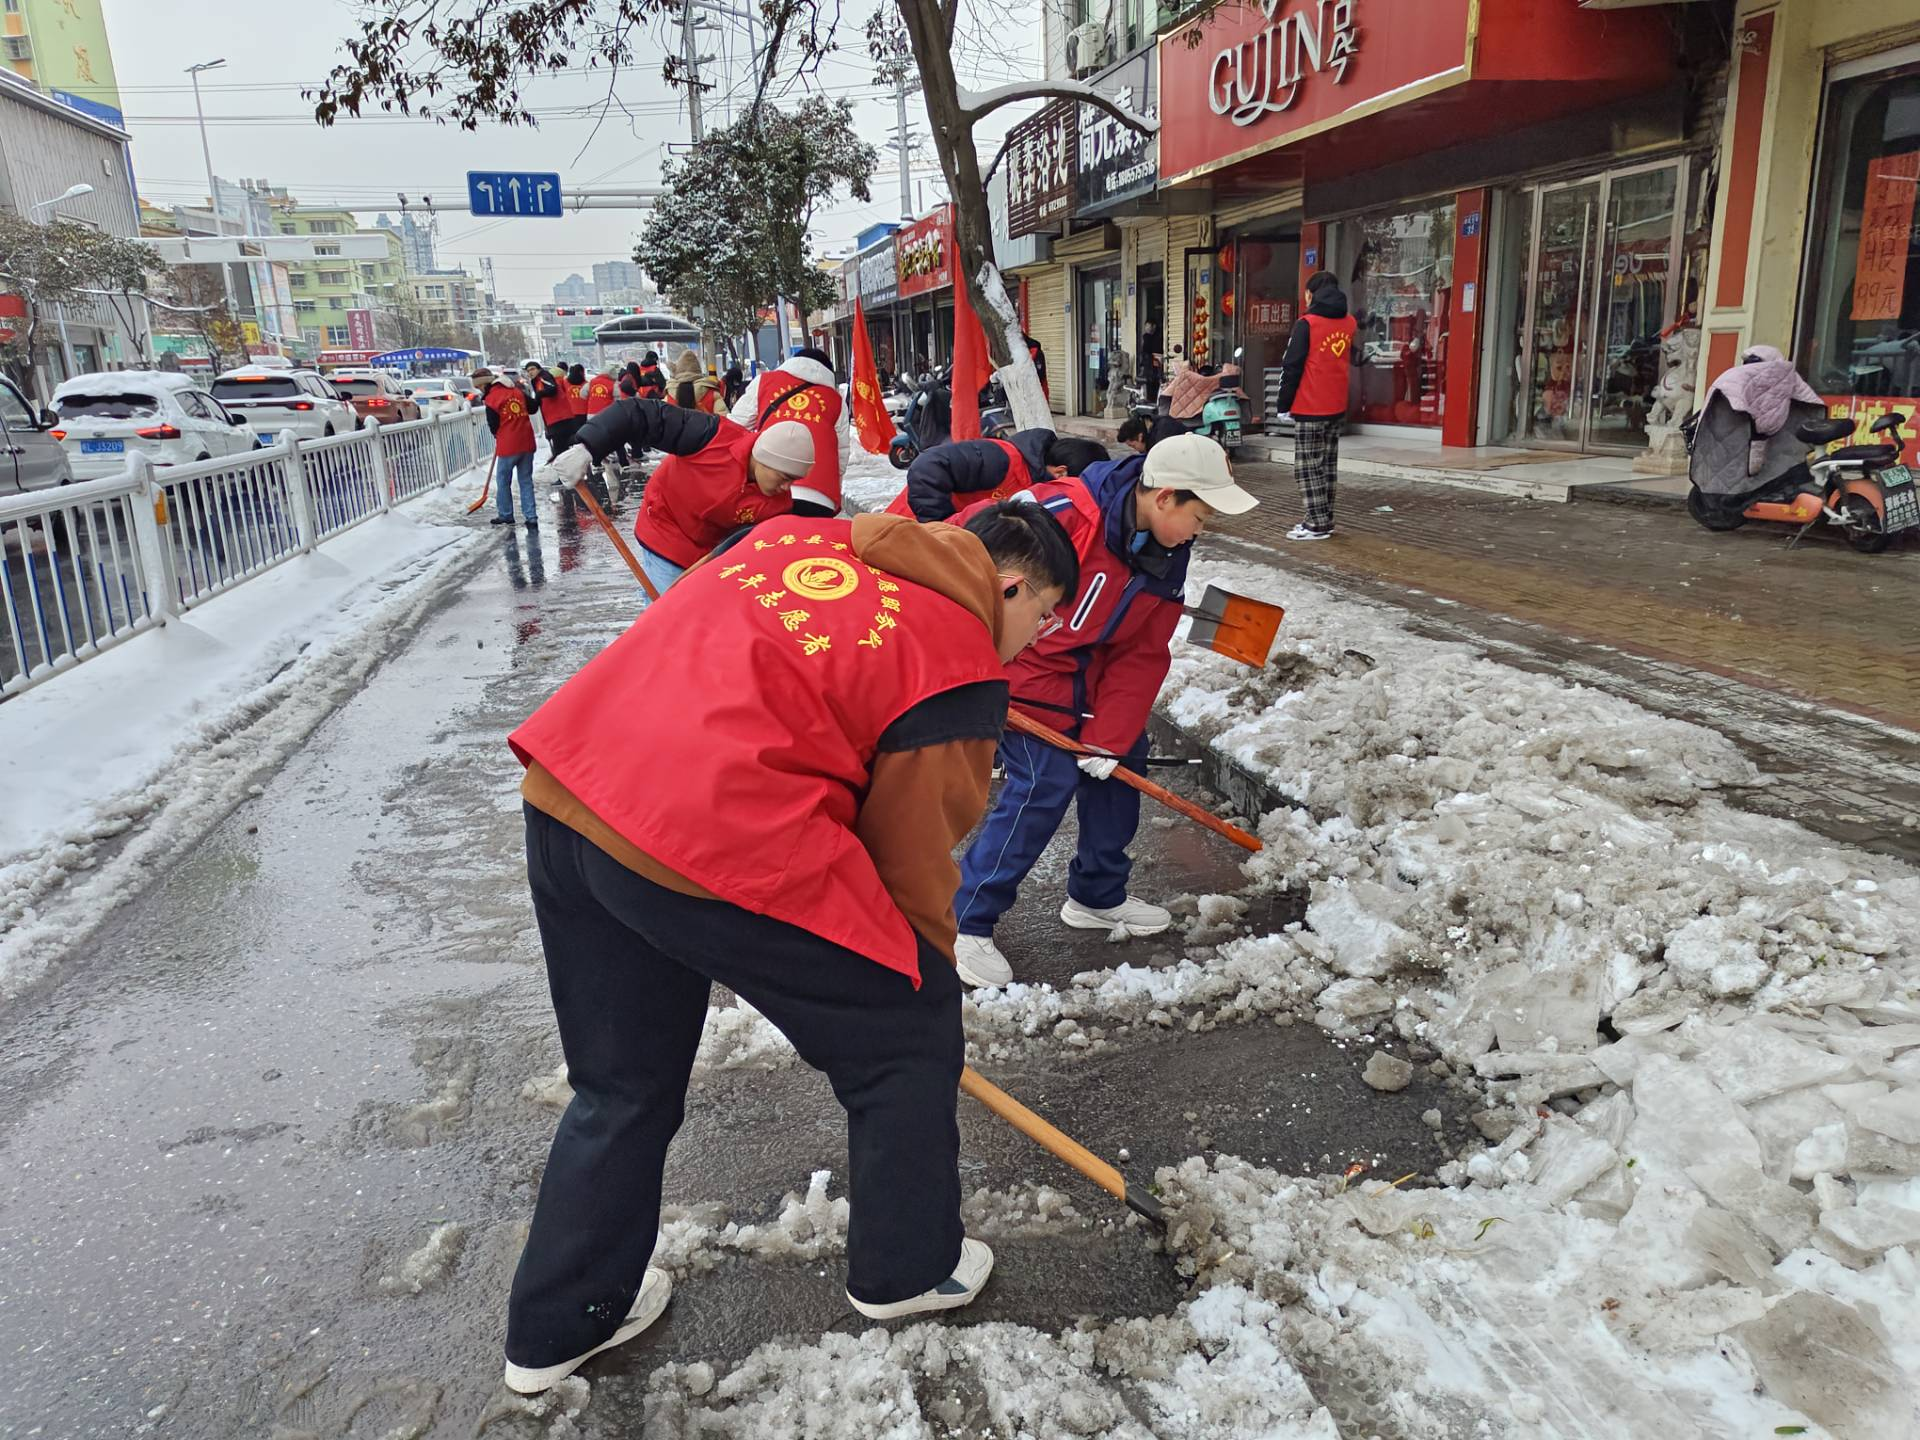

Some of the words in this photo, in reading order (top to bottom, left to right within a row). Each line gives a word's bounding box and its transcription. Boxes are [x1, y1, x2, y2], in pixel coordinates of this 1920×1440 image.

[1209, 0, 1323, 126] GUJIN
[1250, 303, 1291, 323] 门面出租
[718, 563, 832, 656] 青年志愿者
